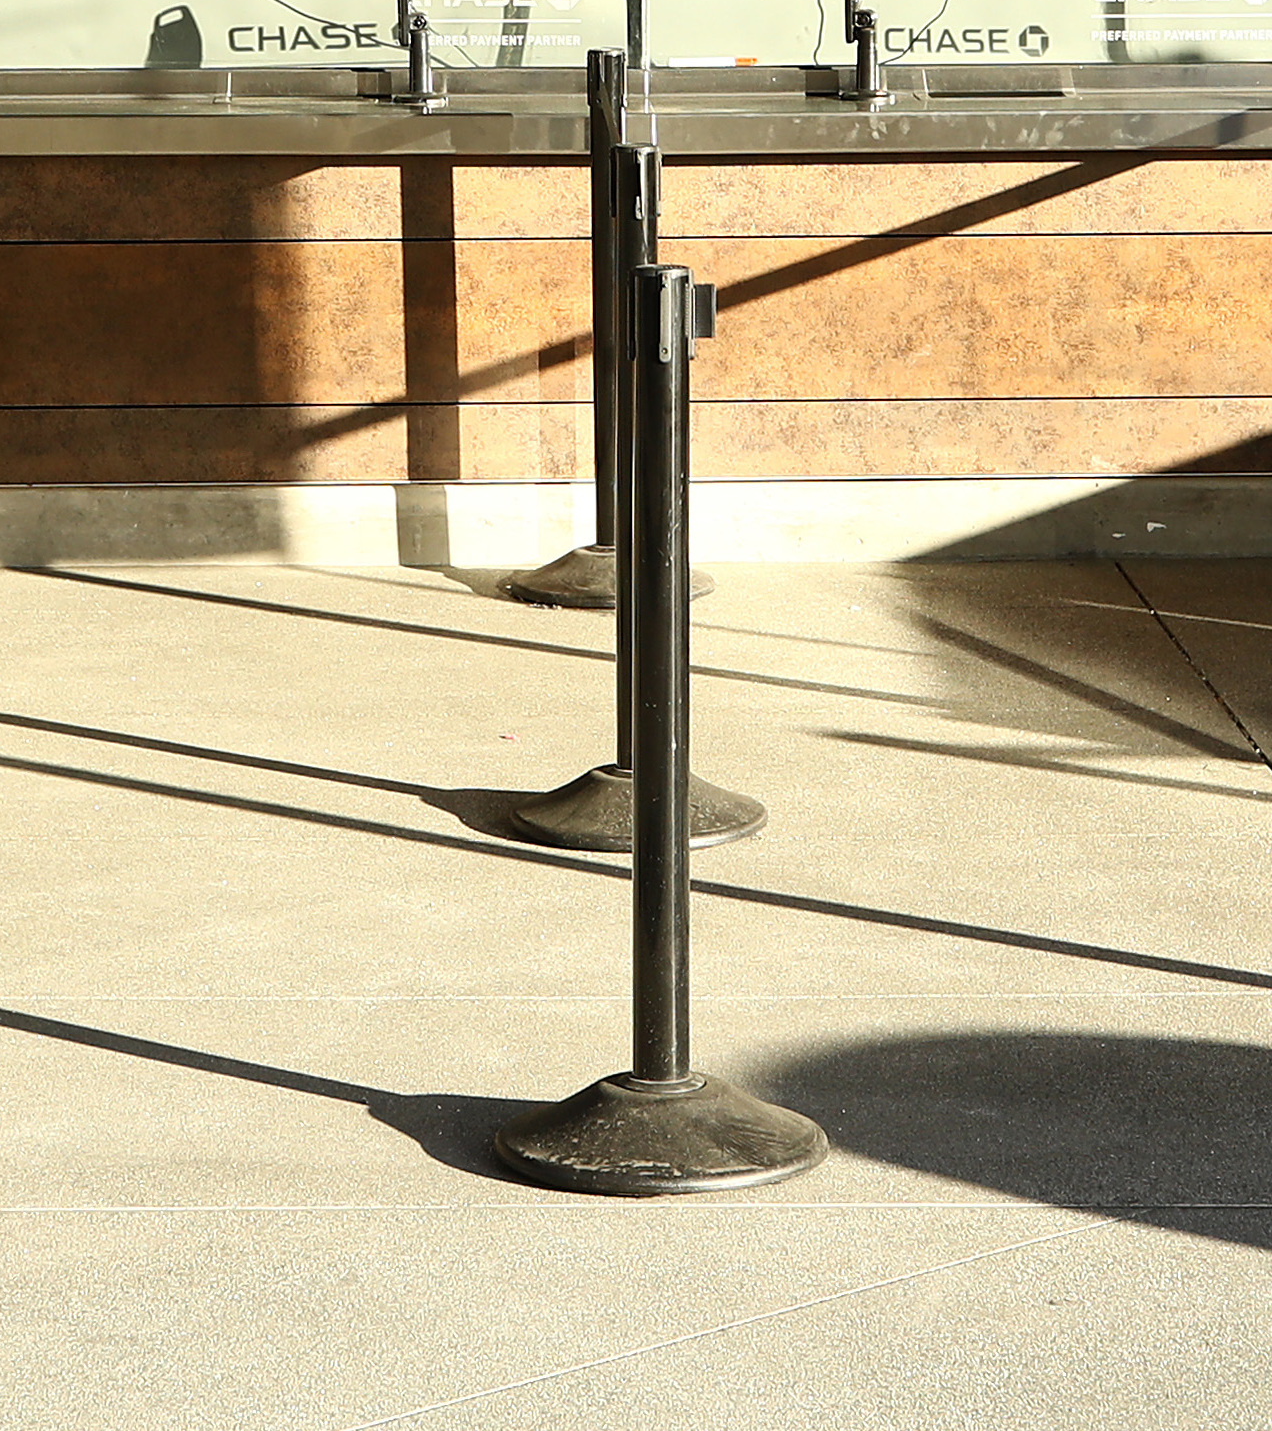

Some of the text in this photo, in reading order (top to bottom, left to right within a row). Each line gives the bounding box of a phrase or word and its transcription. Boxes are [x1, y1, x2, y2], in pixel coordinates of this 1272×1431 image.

[227, 23, 379, 53] CHASE
[428, 34, 581, 46] ERRED PAYMENT PARTNER
[884, 27, 1010, 54] CHASE
[1091, 30, 1161, 42] PREFERRED
[1164, 29, 1217, 41] PAYMENT
